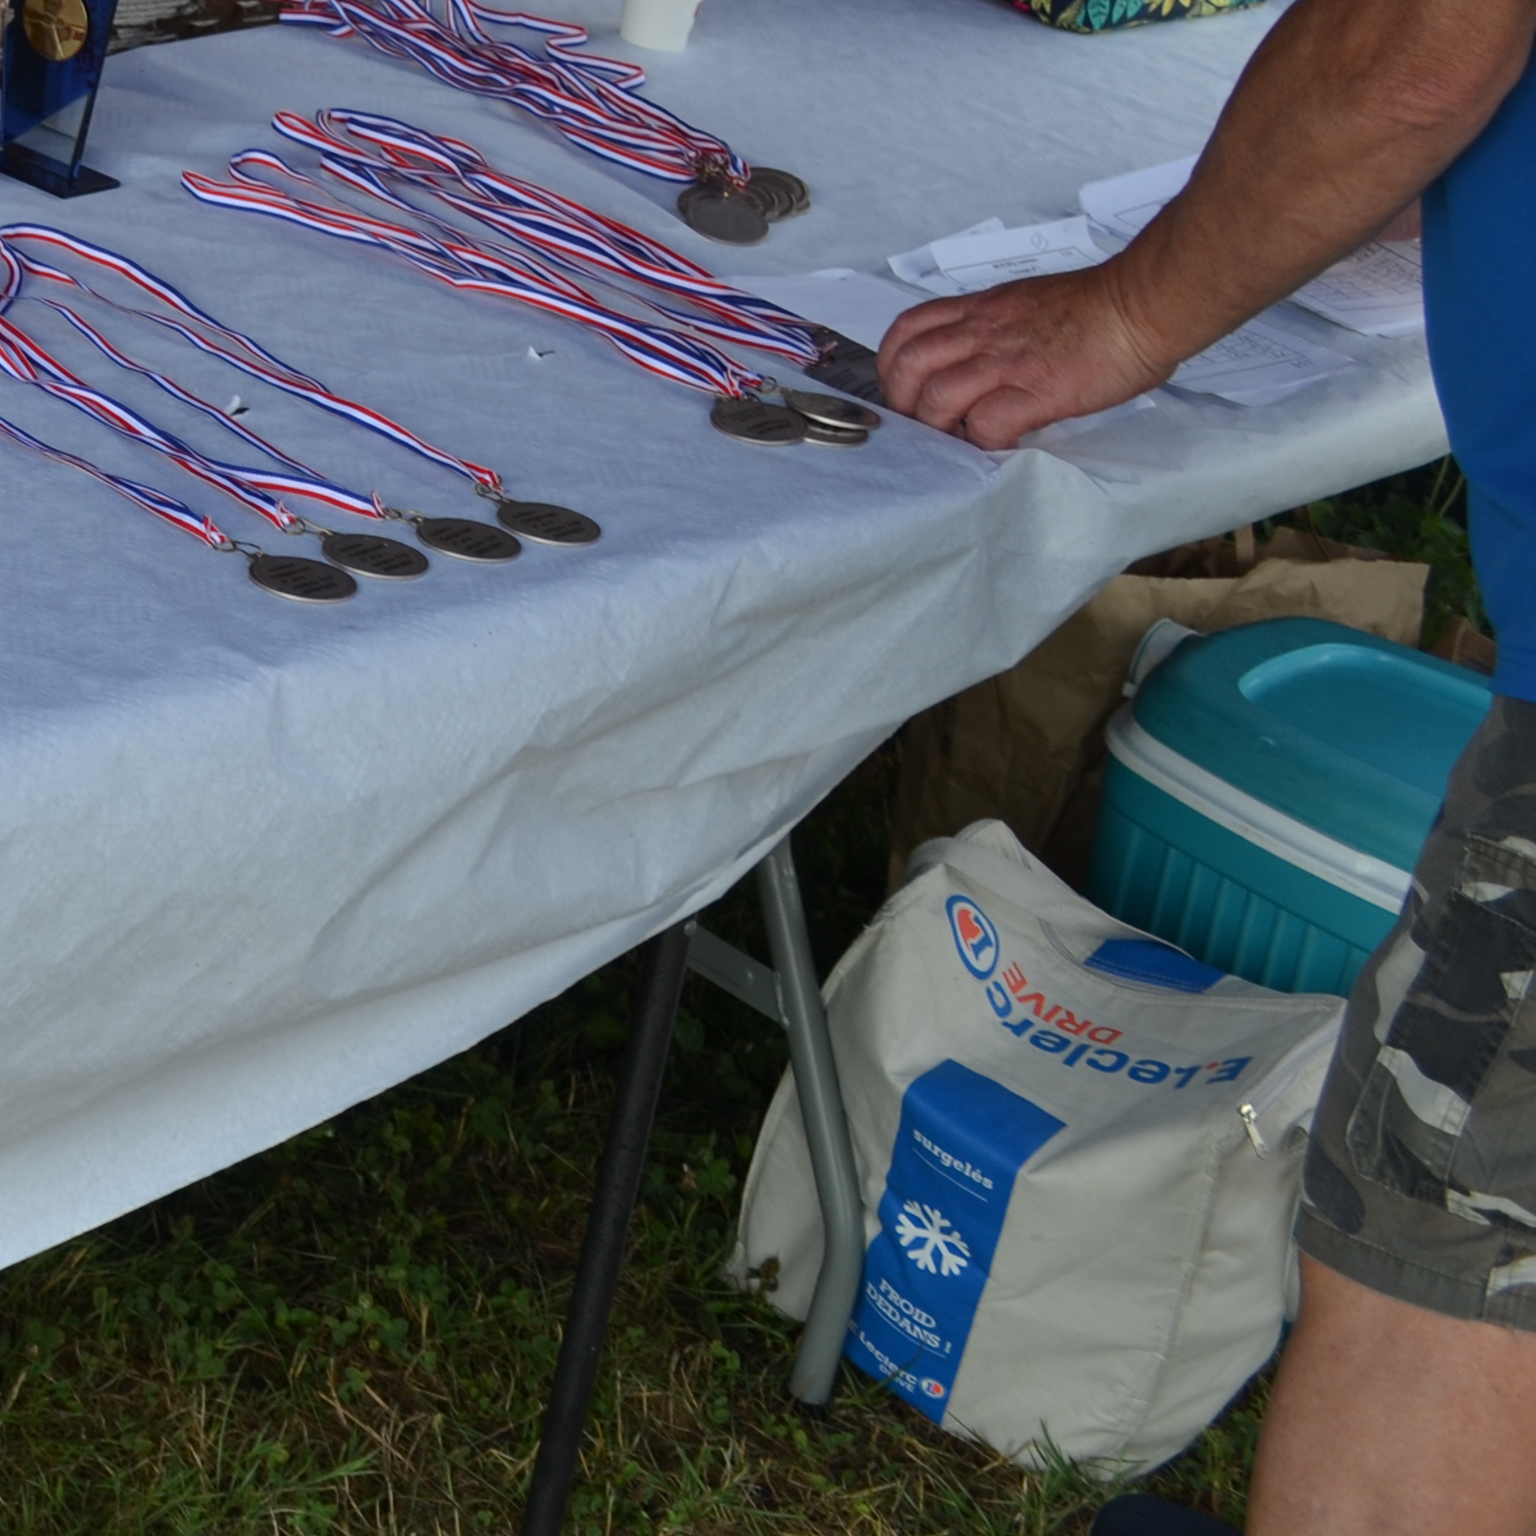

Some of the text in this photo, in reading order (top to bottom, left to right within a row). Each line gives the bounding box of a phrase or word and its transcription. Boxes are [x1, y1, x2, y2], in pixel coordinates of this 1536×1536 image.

[1001, 960, 1123, 1046] DRIVE
[912, 1128, 995, 1191] surgelés
[865, 1280, 942, 1349] DEDANS
[879, 1277, 937, 1329] FROID
